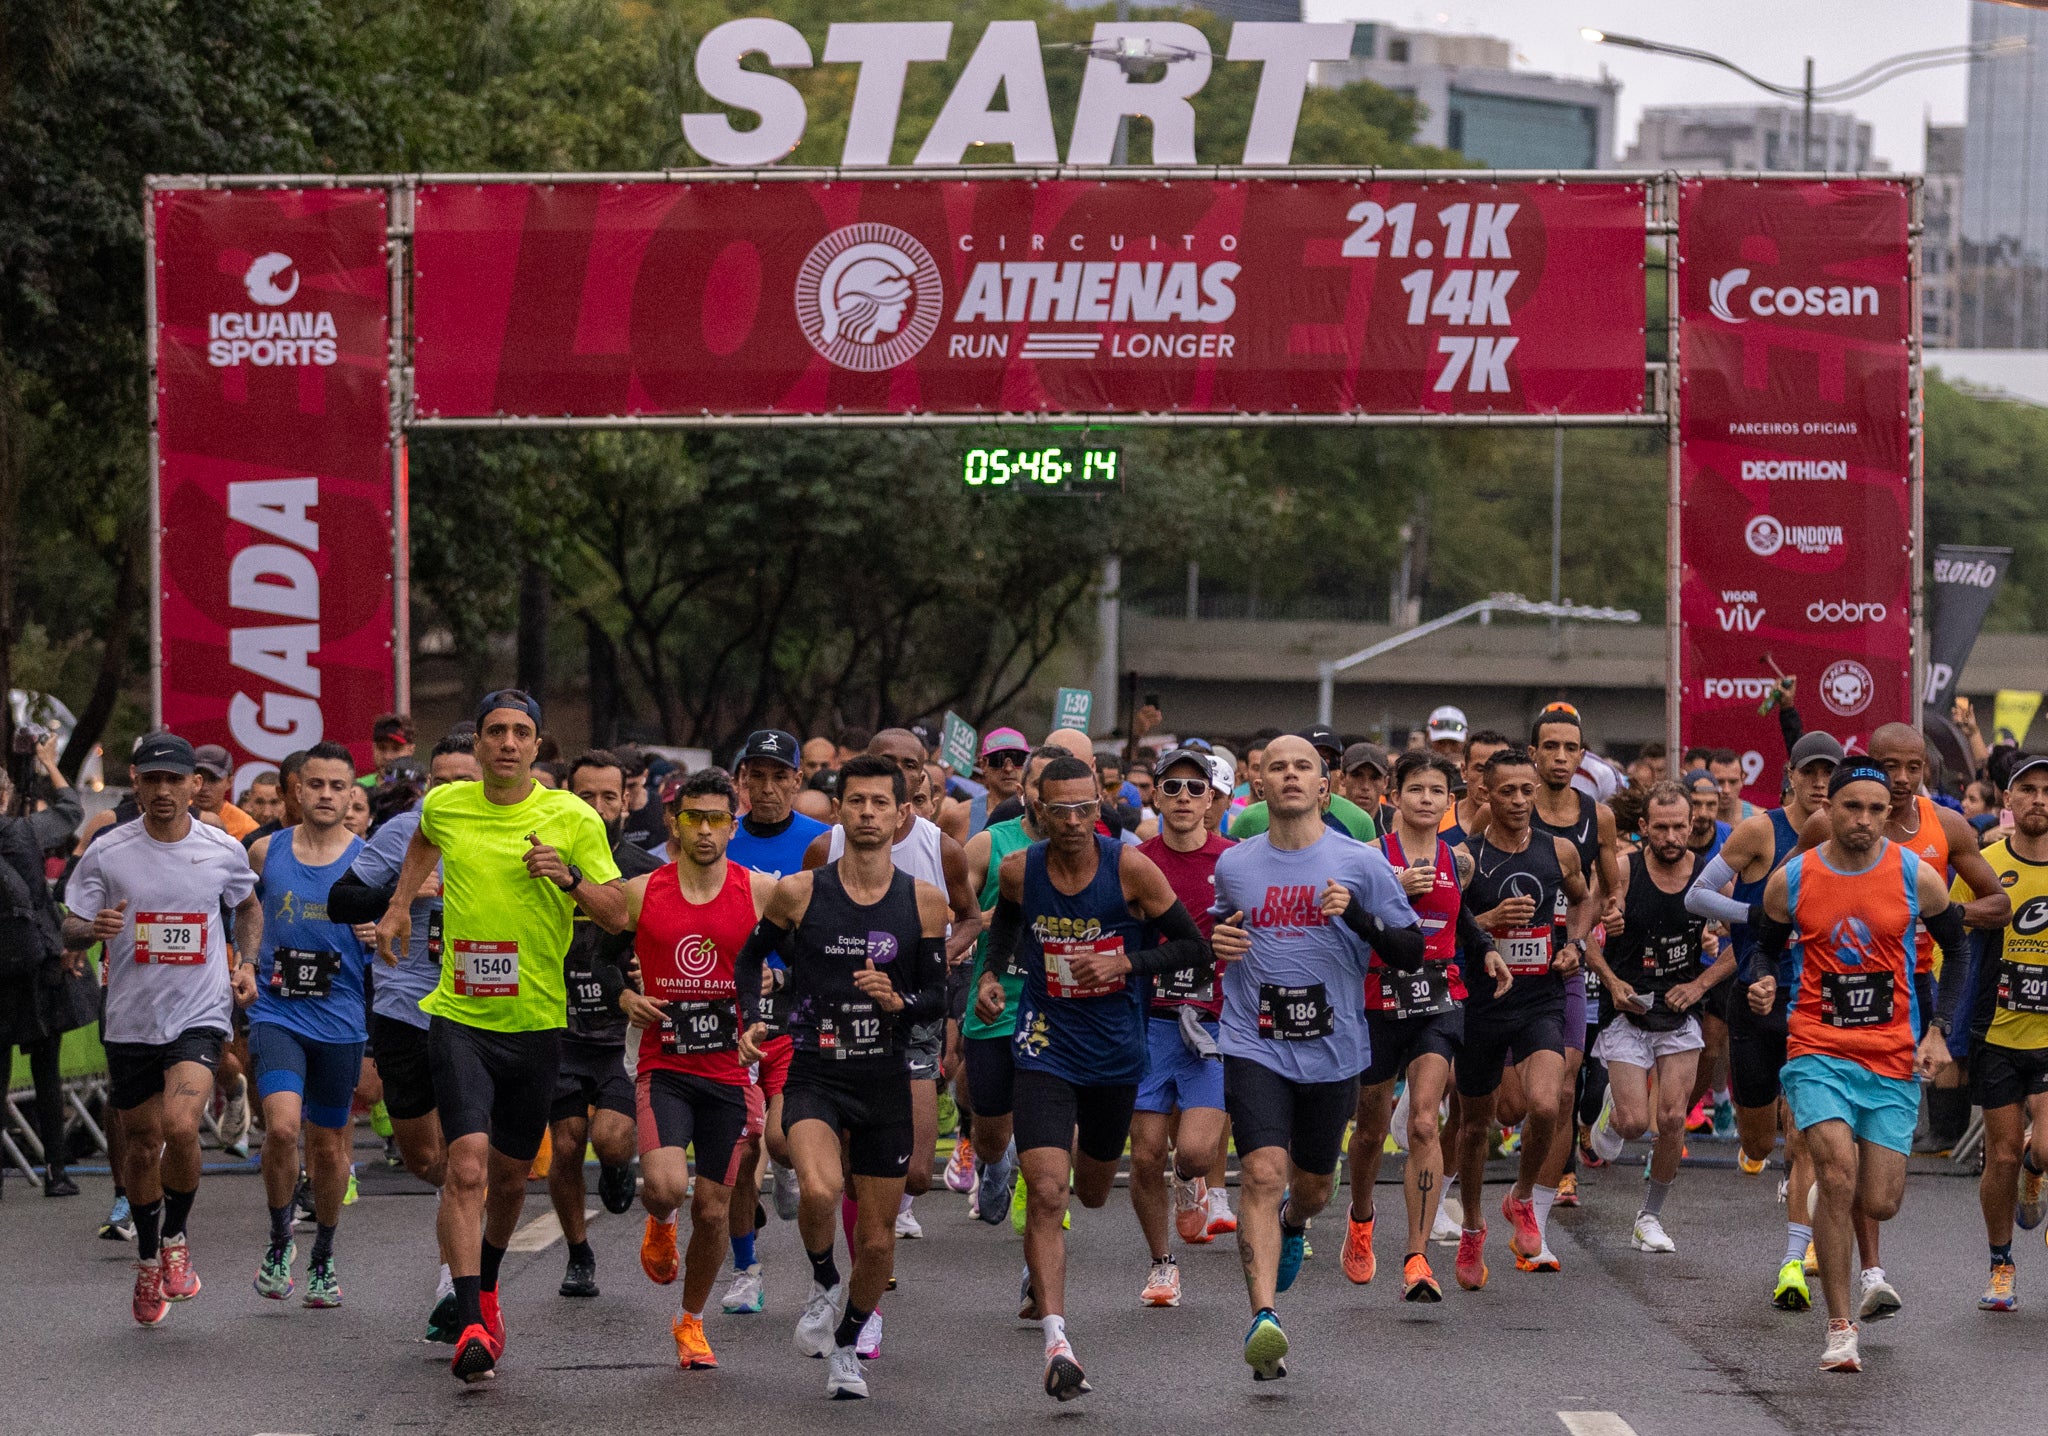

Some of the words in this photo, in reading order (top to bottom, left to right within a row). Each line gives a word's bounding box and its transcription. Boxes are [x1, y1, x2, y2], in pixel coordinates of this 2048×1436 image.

[681, 17, 1356, 165] START
[1341, 201, 1520, 259] 21.1K
[959, 234, 1237, 251] CIRCUITO
[954, 260, 1242, 323] ATHENAS
[1401, 269, 1520, 325] 14K
[1749, 286, 1879, 316] cosan
[208, 312, 337, 339] IGUANA
[208, 339, 337, 367] SPORTS
[949, 334, 1009, 358] RUN
[1111, 334, 1236, 358] LONGER
[1433, 336, 1520, 393] 7K
[1729, 422, 1800, 435] PARCEIROS
[1803, 422, 1857, 435] OFICIAIS
[965, 448, 1117, 485] 05:46:14
[1741, 460, 1847, 480] DECATHLON
[1785, 526, 1843, 546] LINDOYA
[1722, 590, 1758, 603] VIGOR
[1806, 599, 1887, 622] dobro
[1065, 693, 1089, 714] 1:30
[952, 720, 974, 750] 1:30
[1852, 767, 1886, 781] JESUS
[1264, 885, 1316, 908] RUN
[163, 928, 190, 943] 378
[839, 935, 866, 946] Equipe
[825, 945, 845, 954] Dário
[847, 946, 865, 955] Leite
[1510, 942, 1540, 956] 1151
[1666, 943, 1688, 959] 183
[299, 965, 318, 980] 87
[473, 958, 511, 975] 1540
[1174, 968, 1194, 982] 44
[577, 983, 602, 998] 118
[656, 977, 700, 988] VOANDO
[1411, 981, 1430, 997] 30
[2021, 979, 2047, 995] 201
[1846, 988, 1874, 1006] 177
[1286, 1002, 1317, 1020] 186
[689, 1014, 719, 1032] 160
[851, 1019, 880, 1037] 112
